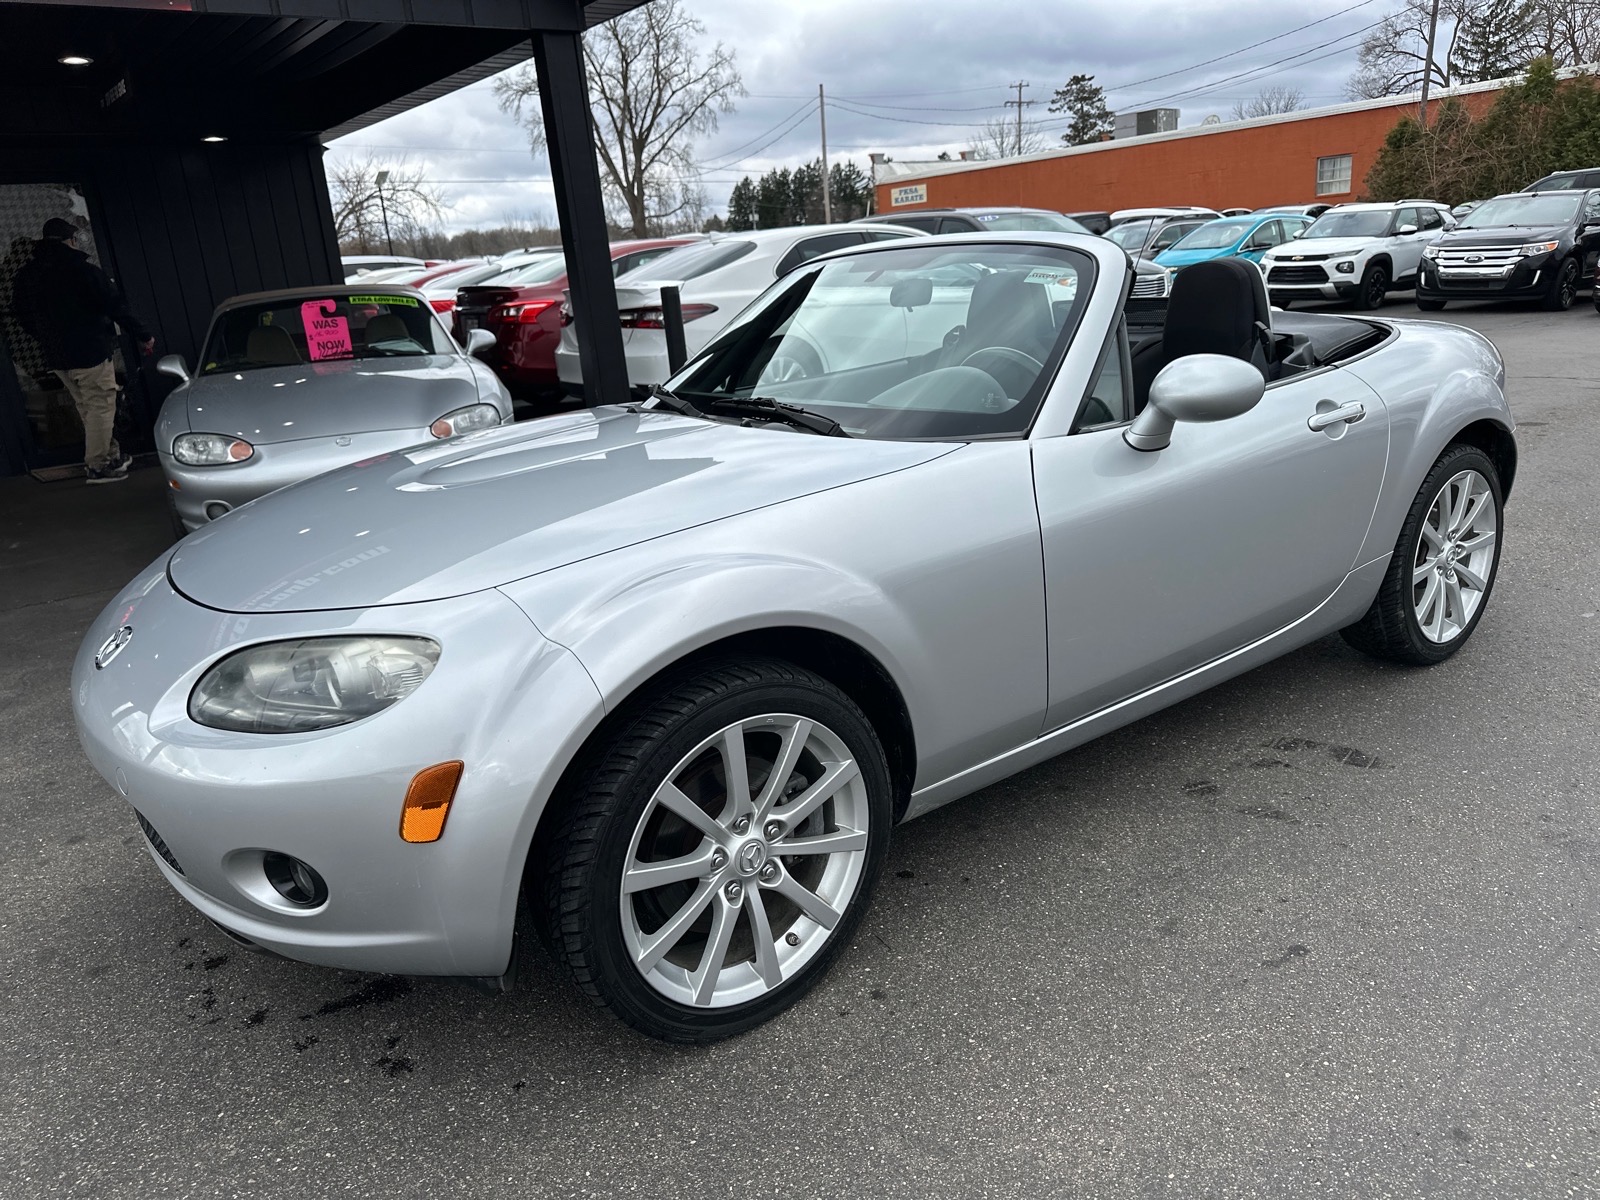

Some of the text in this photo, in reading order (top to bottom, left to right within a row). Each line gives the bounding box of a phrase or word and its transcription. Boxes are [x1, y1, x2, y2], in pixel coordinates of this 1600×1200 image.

[894, 194, 924, 204] KARATE
[391, 297, 416, 305] MILES
[312, 319, 339, 329] WAS
[317, 340, 345, 350] NOW
